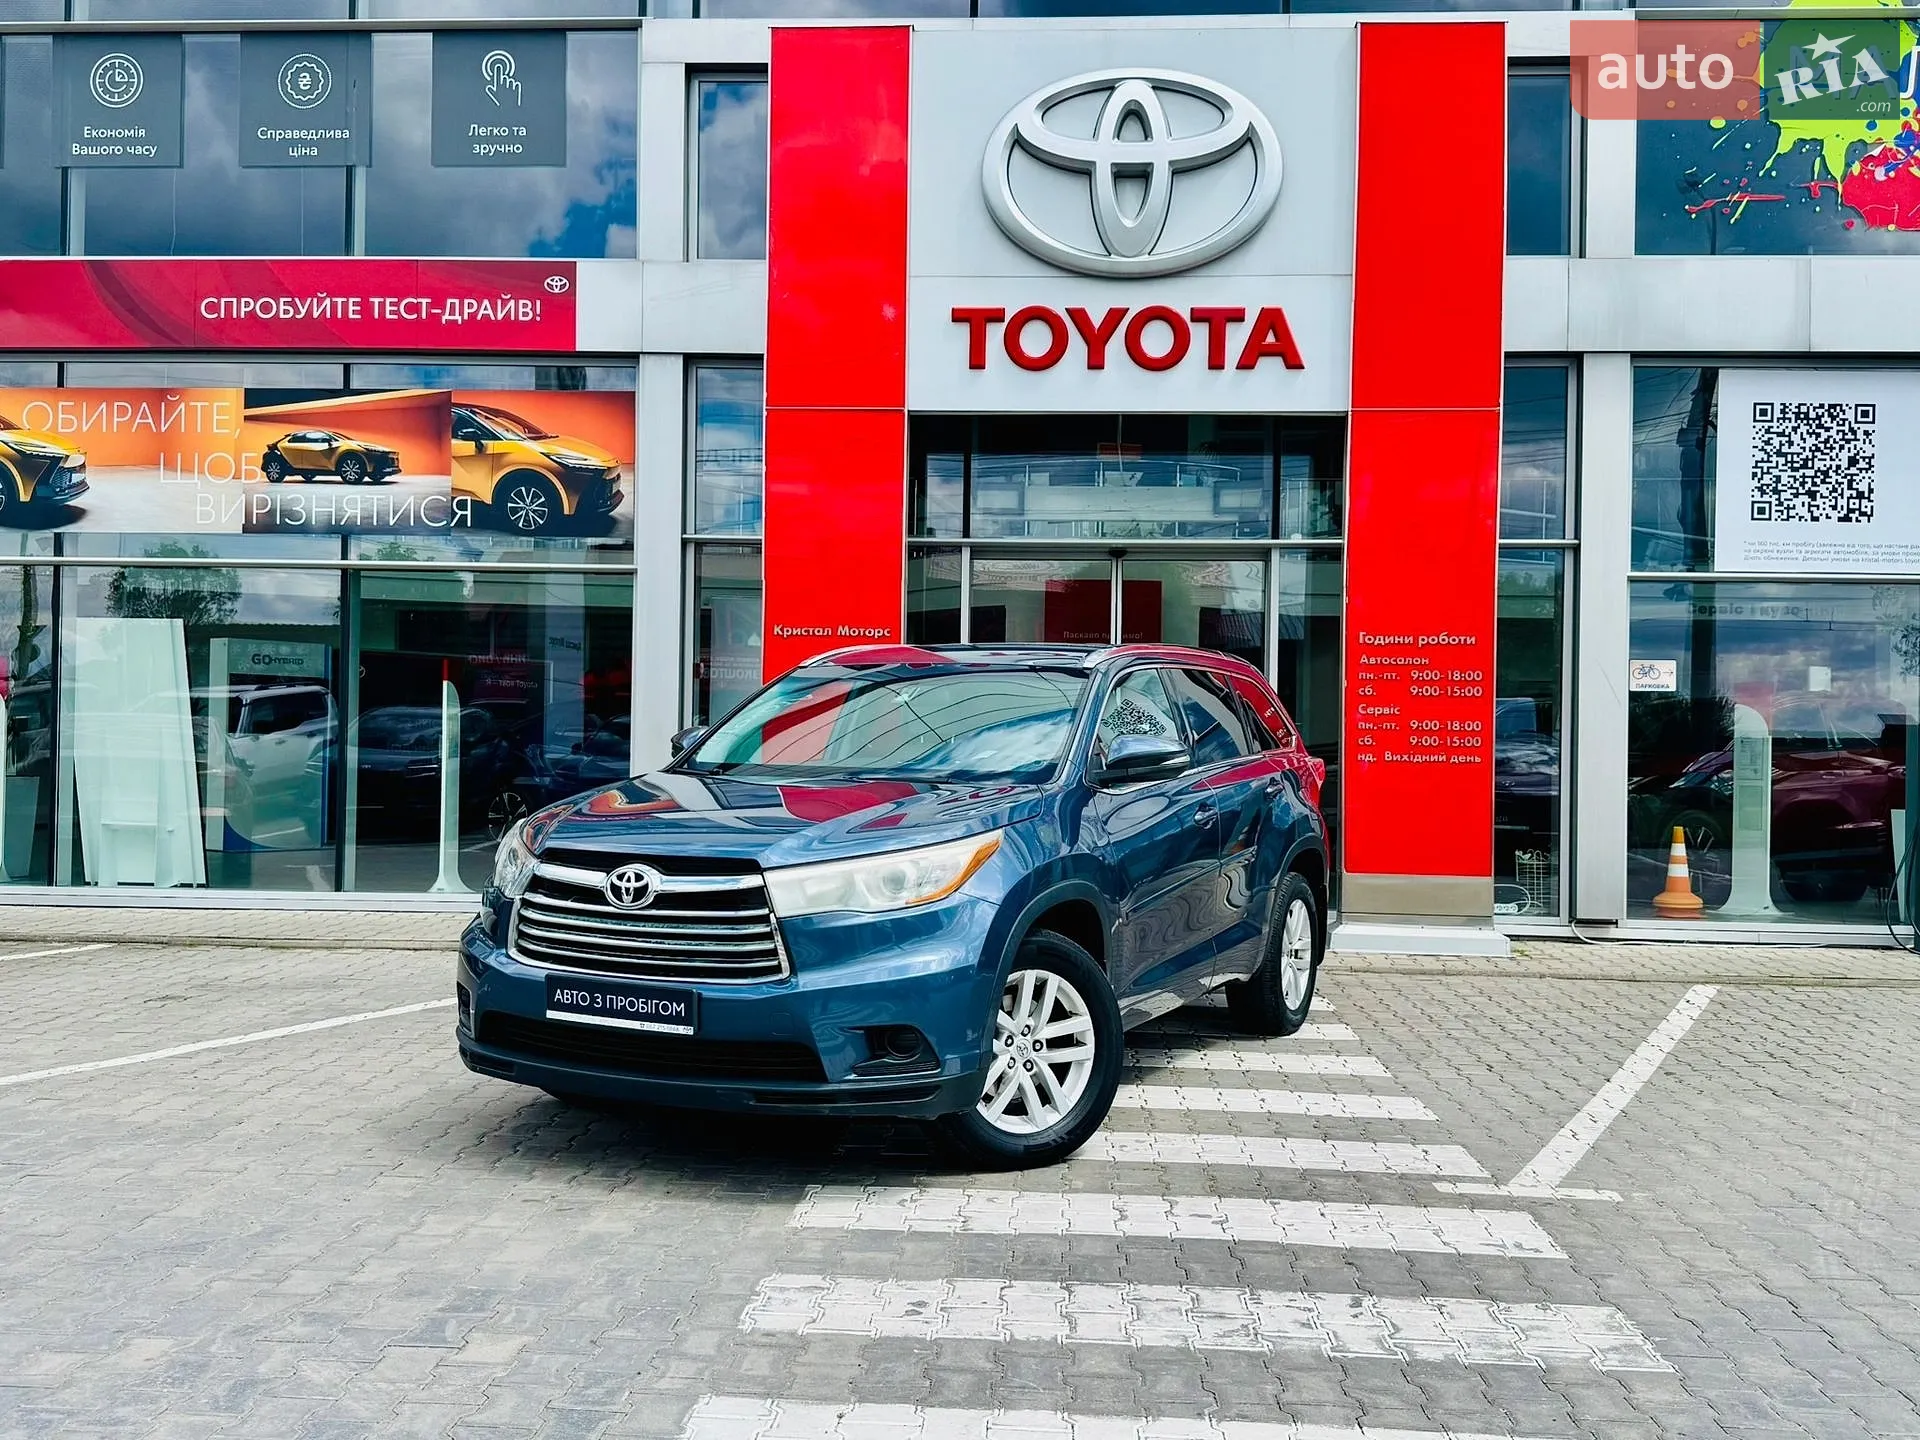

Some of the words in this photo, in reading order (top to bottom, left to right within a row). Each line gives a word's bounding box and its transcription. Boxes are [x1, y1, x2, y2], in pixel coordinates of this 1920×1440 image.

[84, 126, 145, 137] Економія
[257, 127, 350, 141] Справедлива
[468, 124, 506, 138] Легко
[513, 127, 527, 135] та
[73, 144, 124, 154] Вашого
[127, 146, 157, 157] часу
[290, 144, 317, 157] ціна
[473, 144, 523, 156] зручно
[201, 293, 361, 319] СПРОБУЙТЕ
[369, 294, 541, 324] ТЕСТ-ДРАЙВ!
[952, 306, 1304, 371] TOYOTA
[22, 394, 241, 438] ОБИРАЙТЕ,
[159, 452, 261, 487] ЩОБ
[196, 493, 472, 528] ВИРІЗНЯТИСЯ
[774, 625, 831, 637] Кристал
[838, 626, 890, 638] Моторс
[1360, 632, 1413, 645] Години
[1419, 632, 1475, 647] роботи
[1360, 655, 1428, 664] Автосалон
[1411, 670, 1482, 680] 9:00-18:00
[1359, 685, 1376, 695] сб.
[1410, 686, 1482, 696] 9:00-15:00
[1359, 704, 1399, 716] Сервіс
[1410, 720, 1481, 730] 9:00-18:00
[1358, 735, 1376, 746] сб.
[1410, 736, 1481, 746] 9:00-15:00
[1358, 754, 1376, 762] нд.
[1385, 751, 1446, 762] Вихідний
[555, 988, 590, 1006] АВТО
[594, 993, 602, 1008] З
[606, 995, 685, 1017] ПРОБІГОМ
